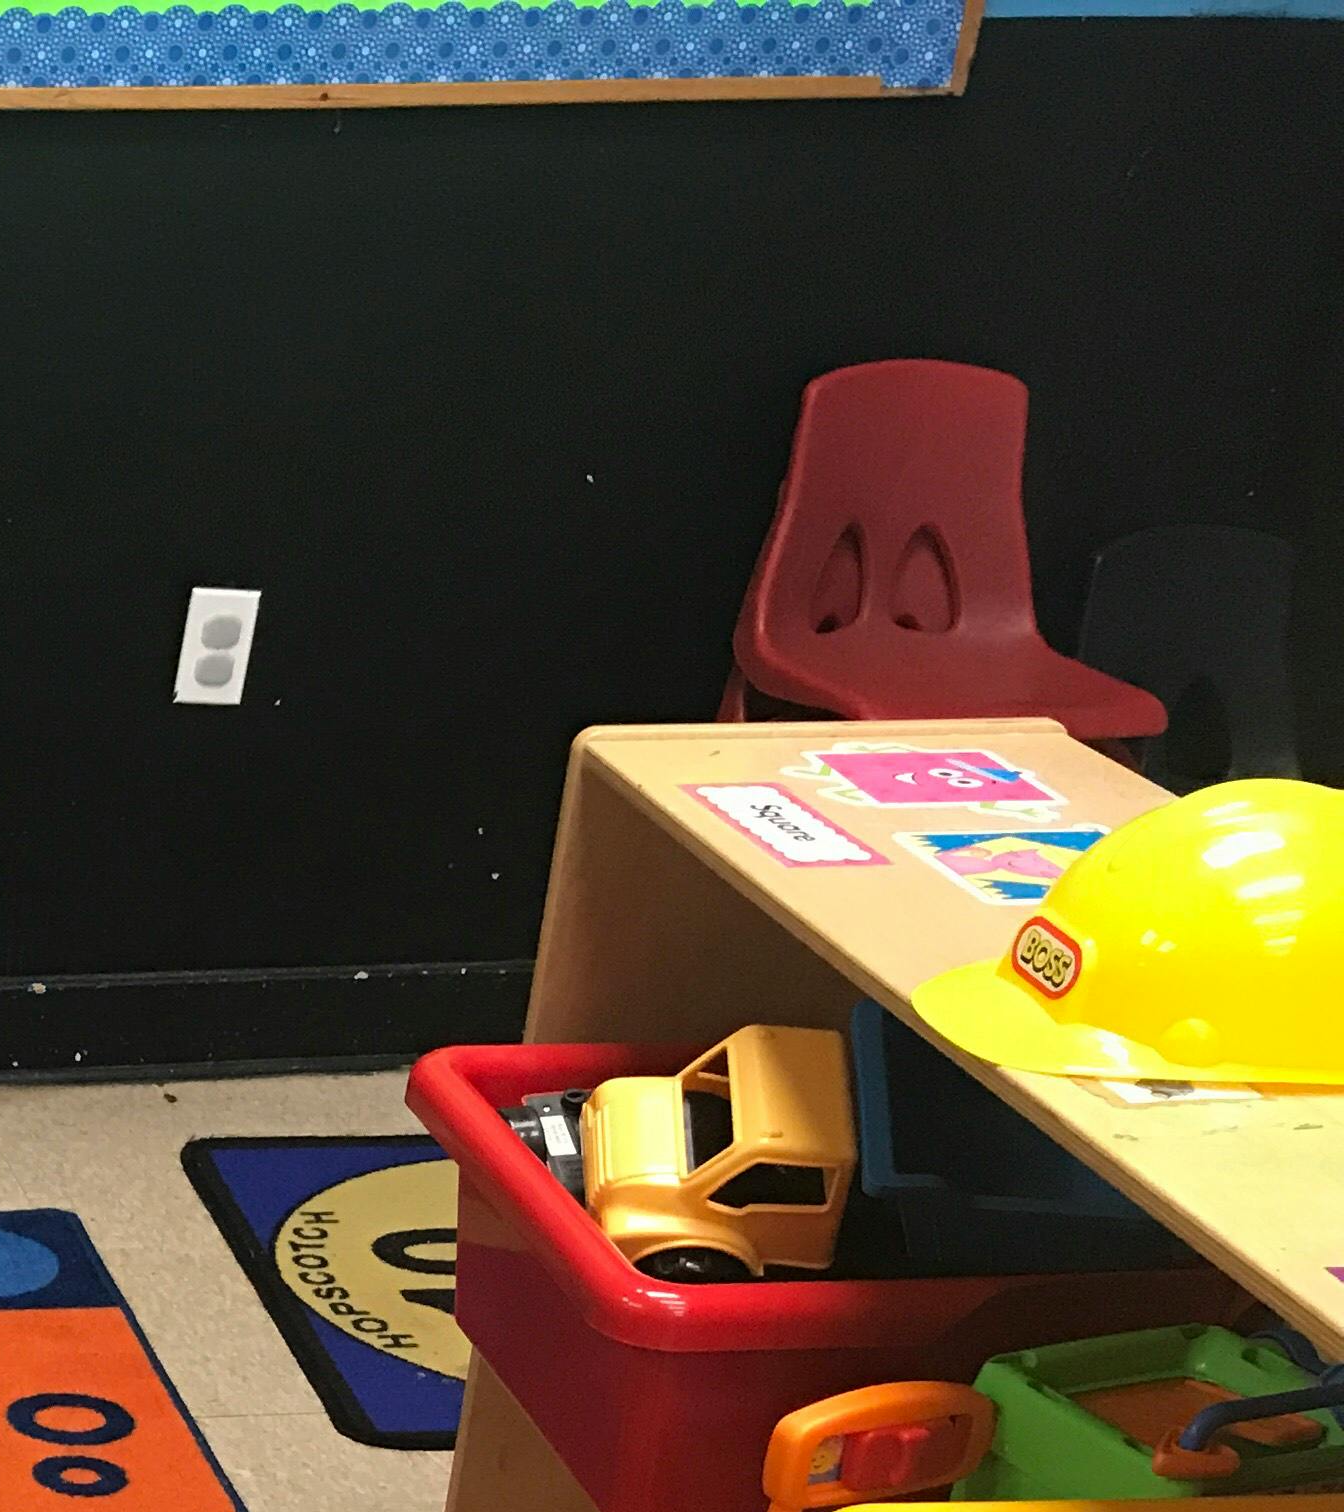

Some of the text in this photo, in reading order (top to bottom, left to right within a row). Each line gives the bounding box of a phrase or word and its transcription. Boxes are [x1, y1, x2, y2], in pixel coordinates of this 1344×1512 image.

[749, 804, 816, 842] Square
[1019, 928, 1073, 989] BOSS
[287, 1210, 421, 1350] HOPSCOTCH
[7, 1393, 136, 1497] Oo
